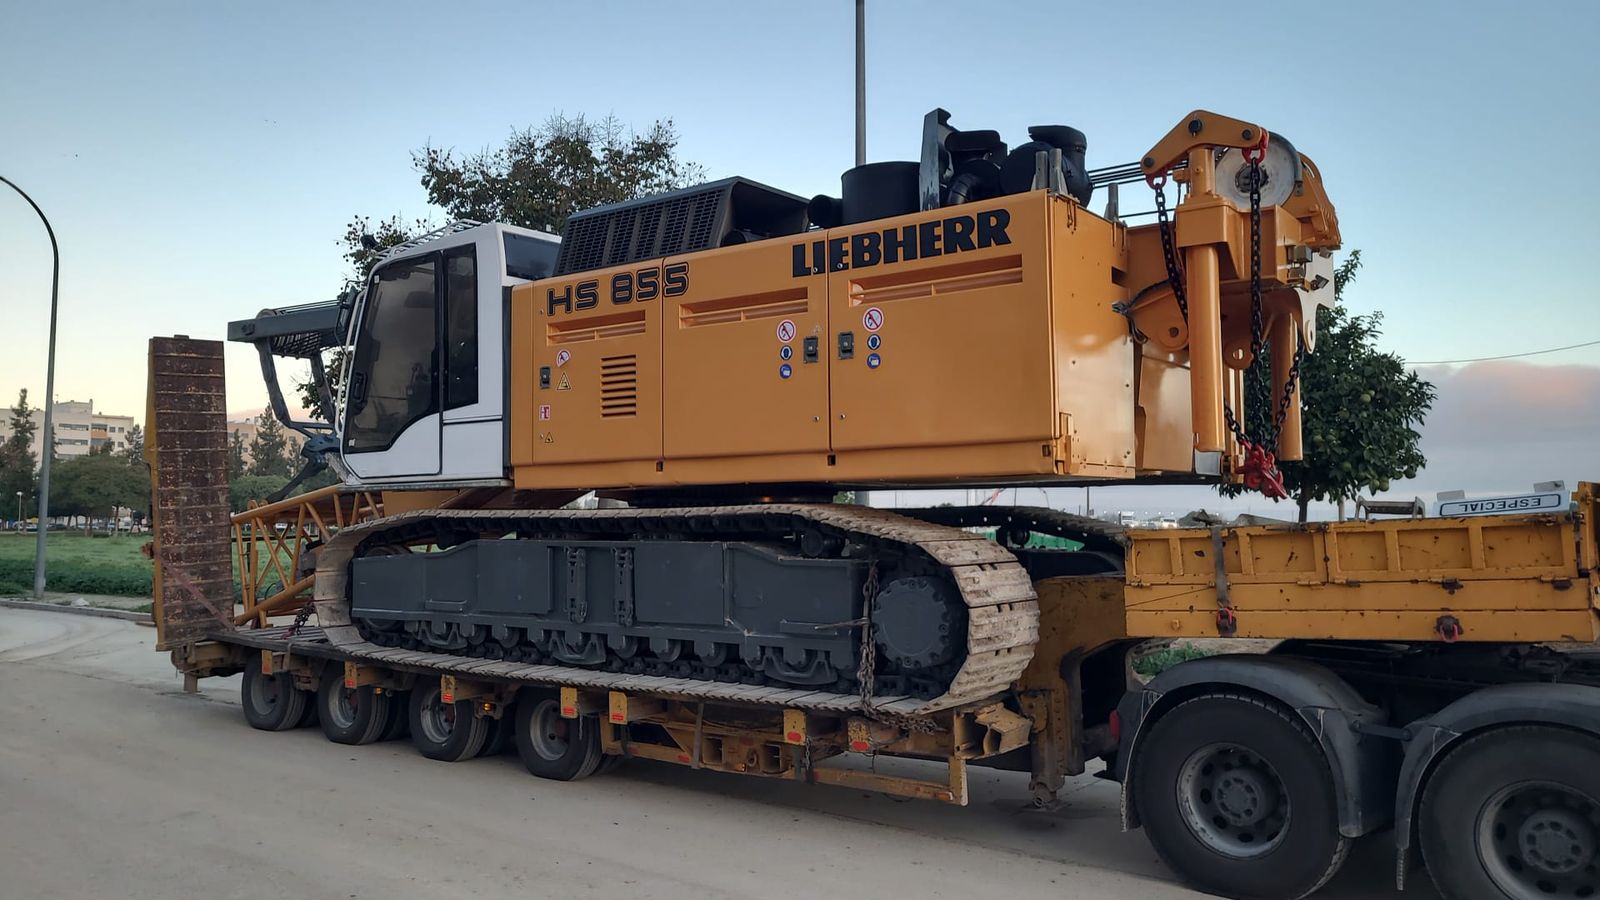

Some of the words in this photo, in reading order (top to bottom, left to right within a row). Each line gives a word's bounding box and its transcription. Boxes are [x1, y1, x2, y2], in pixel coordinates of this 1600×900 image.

[792, 208, 1012, 278] LIEBHERR
[546, 279, 599, 317] HS
[611, 261, 690, 305] 855
[1459, 497, 1541, 513] ESPECIAL
